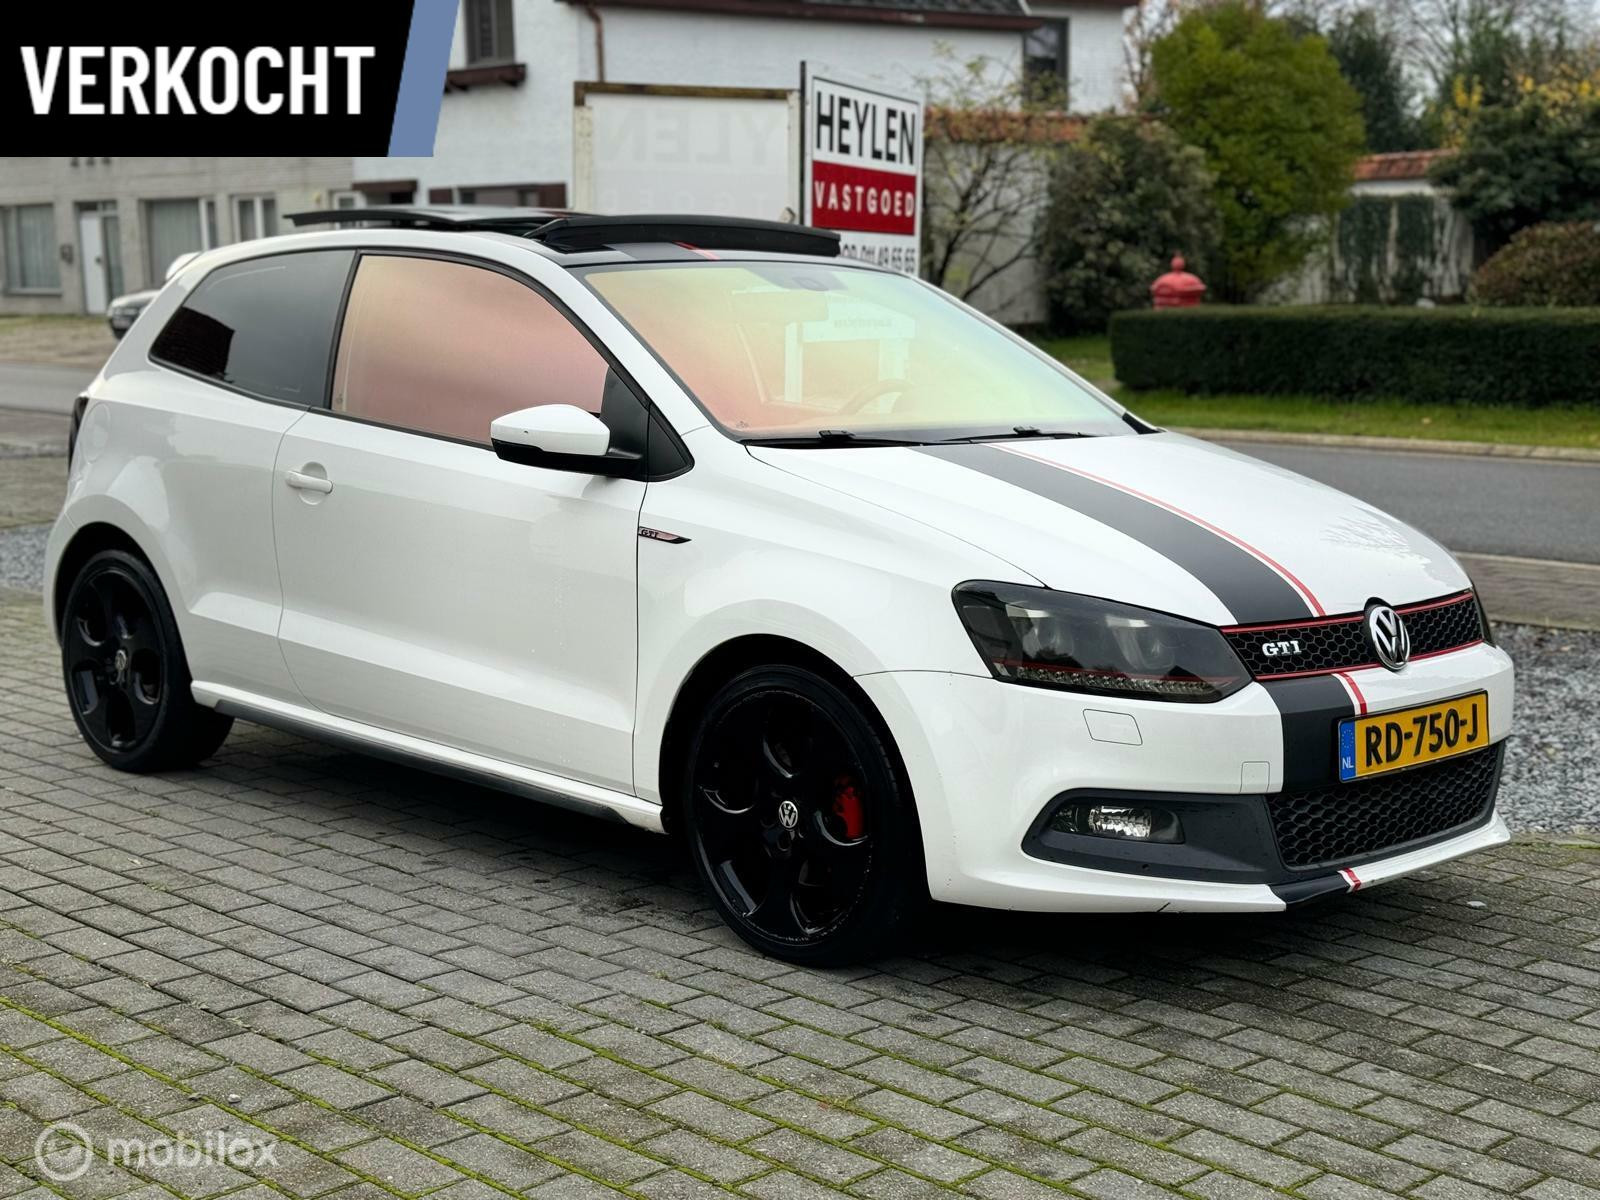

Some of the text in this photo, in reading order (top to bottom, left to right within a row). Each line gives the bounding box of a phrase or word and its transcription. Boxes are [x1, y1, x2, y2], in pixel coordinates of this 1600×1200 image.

[815, 91, 916, 165] HEYLEN
[814, 180, 916, 218] VASTGOED
[1261, 640, 1302, 657] GTI
[1365, 703, 1478, 768] RD-750-J
[1342, 756, 1354, 769] NL
